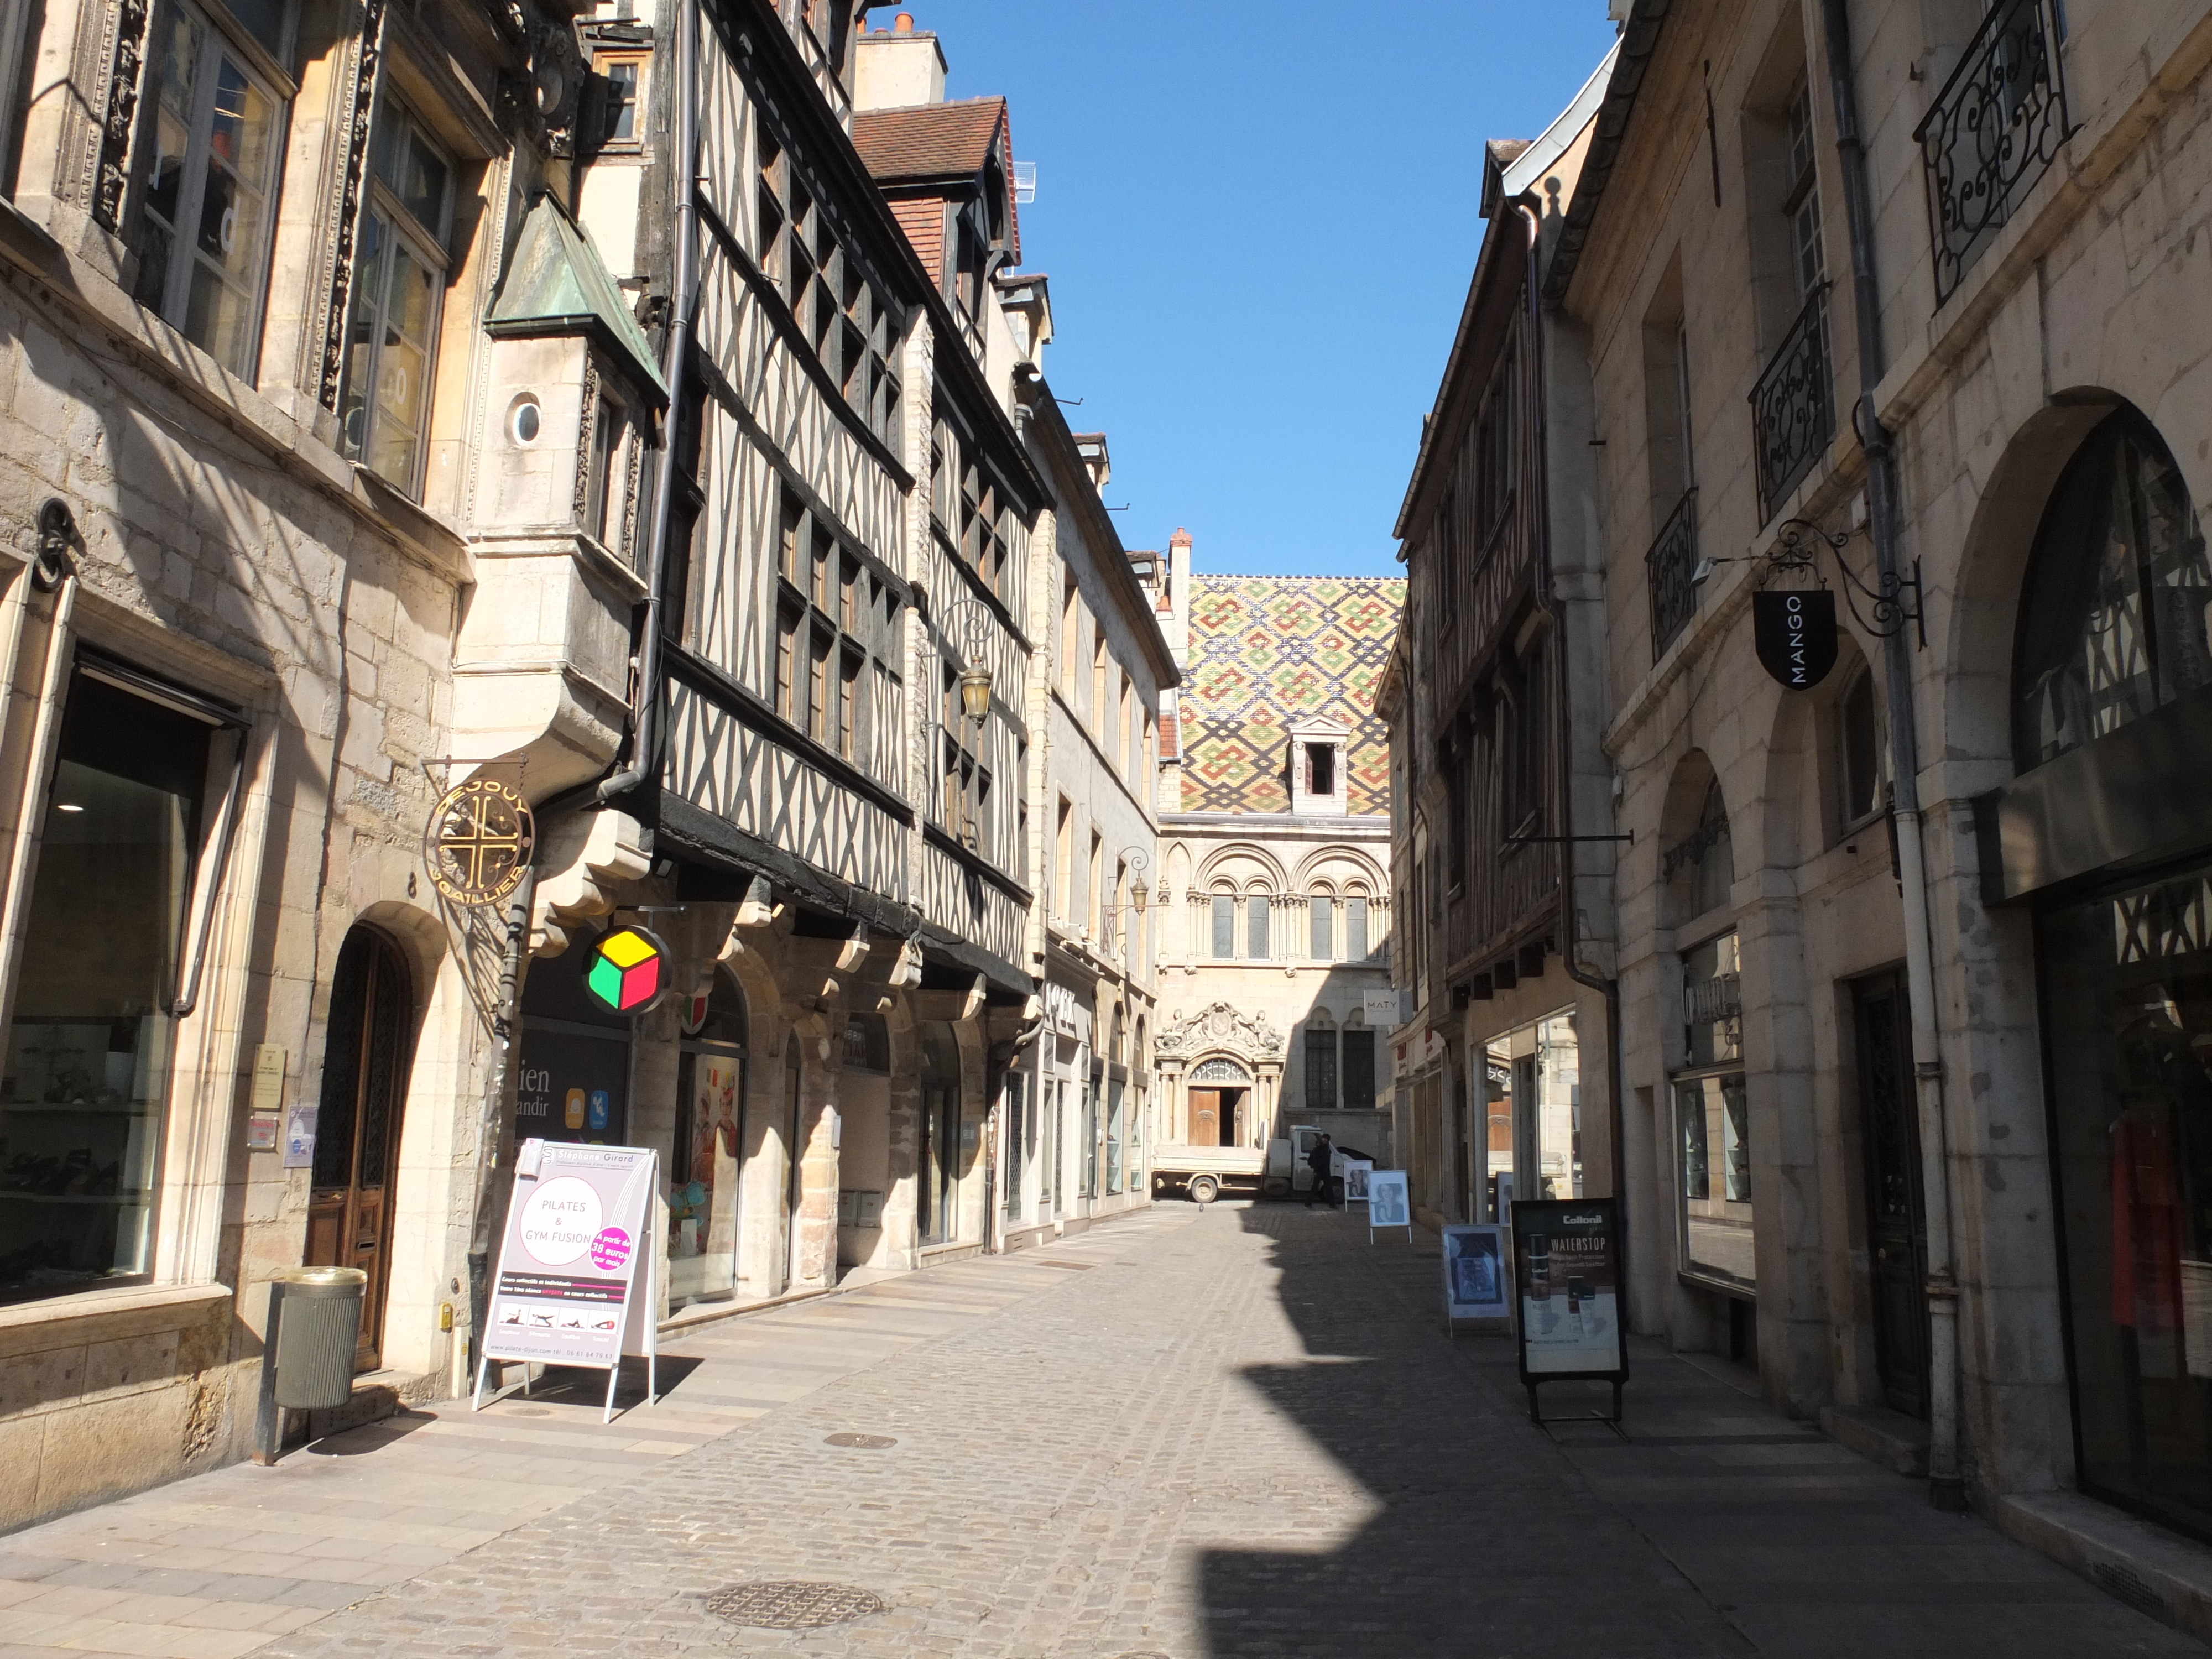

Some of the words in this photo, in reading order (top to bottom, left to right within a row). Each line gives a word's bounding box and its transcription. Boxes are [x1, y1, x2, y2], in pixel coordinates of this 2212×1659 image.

[1786, 596, 1807, 684] MANGO
[435, 781, 528, 815] DEJOUY
[407, 872, 417, 899] 8
[430, 866, 523, 904] JOAILLIER
[518, 1059, 550, 1093] ien
[516, 1095, 549, 1117] andir
[558, 1150, 600, 1161] Stéphane
[604, 1153, 634, 1162] Girard
[542, 1200, 586, 1212] PILATES
[555, 1217, 562, 1225] &
[1563, 1215, 1603, 1224] Collonil
[526, 1230, 548, 1240] GYM
[552, 1232, 591, 1244] FUSION
[603, 1236, 622, 1244] partir
[622, 1239, 631, 1248] de
[1551, 1237, 1605, 1251] WATERSTOP
[591, 1242, 604, 1253] 38
[605, 1248, 629, 1260] euros
[606, 1258, 621, 1267] mois
